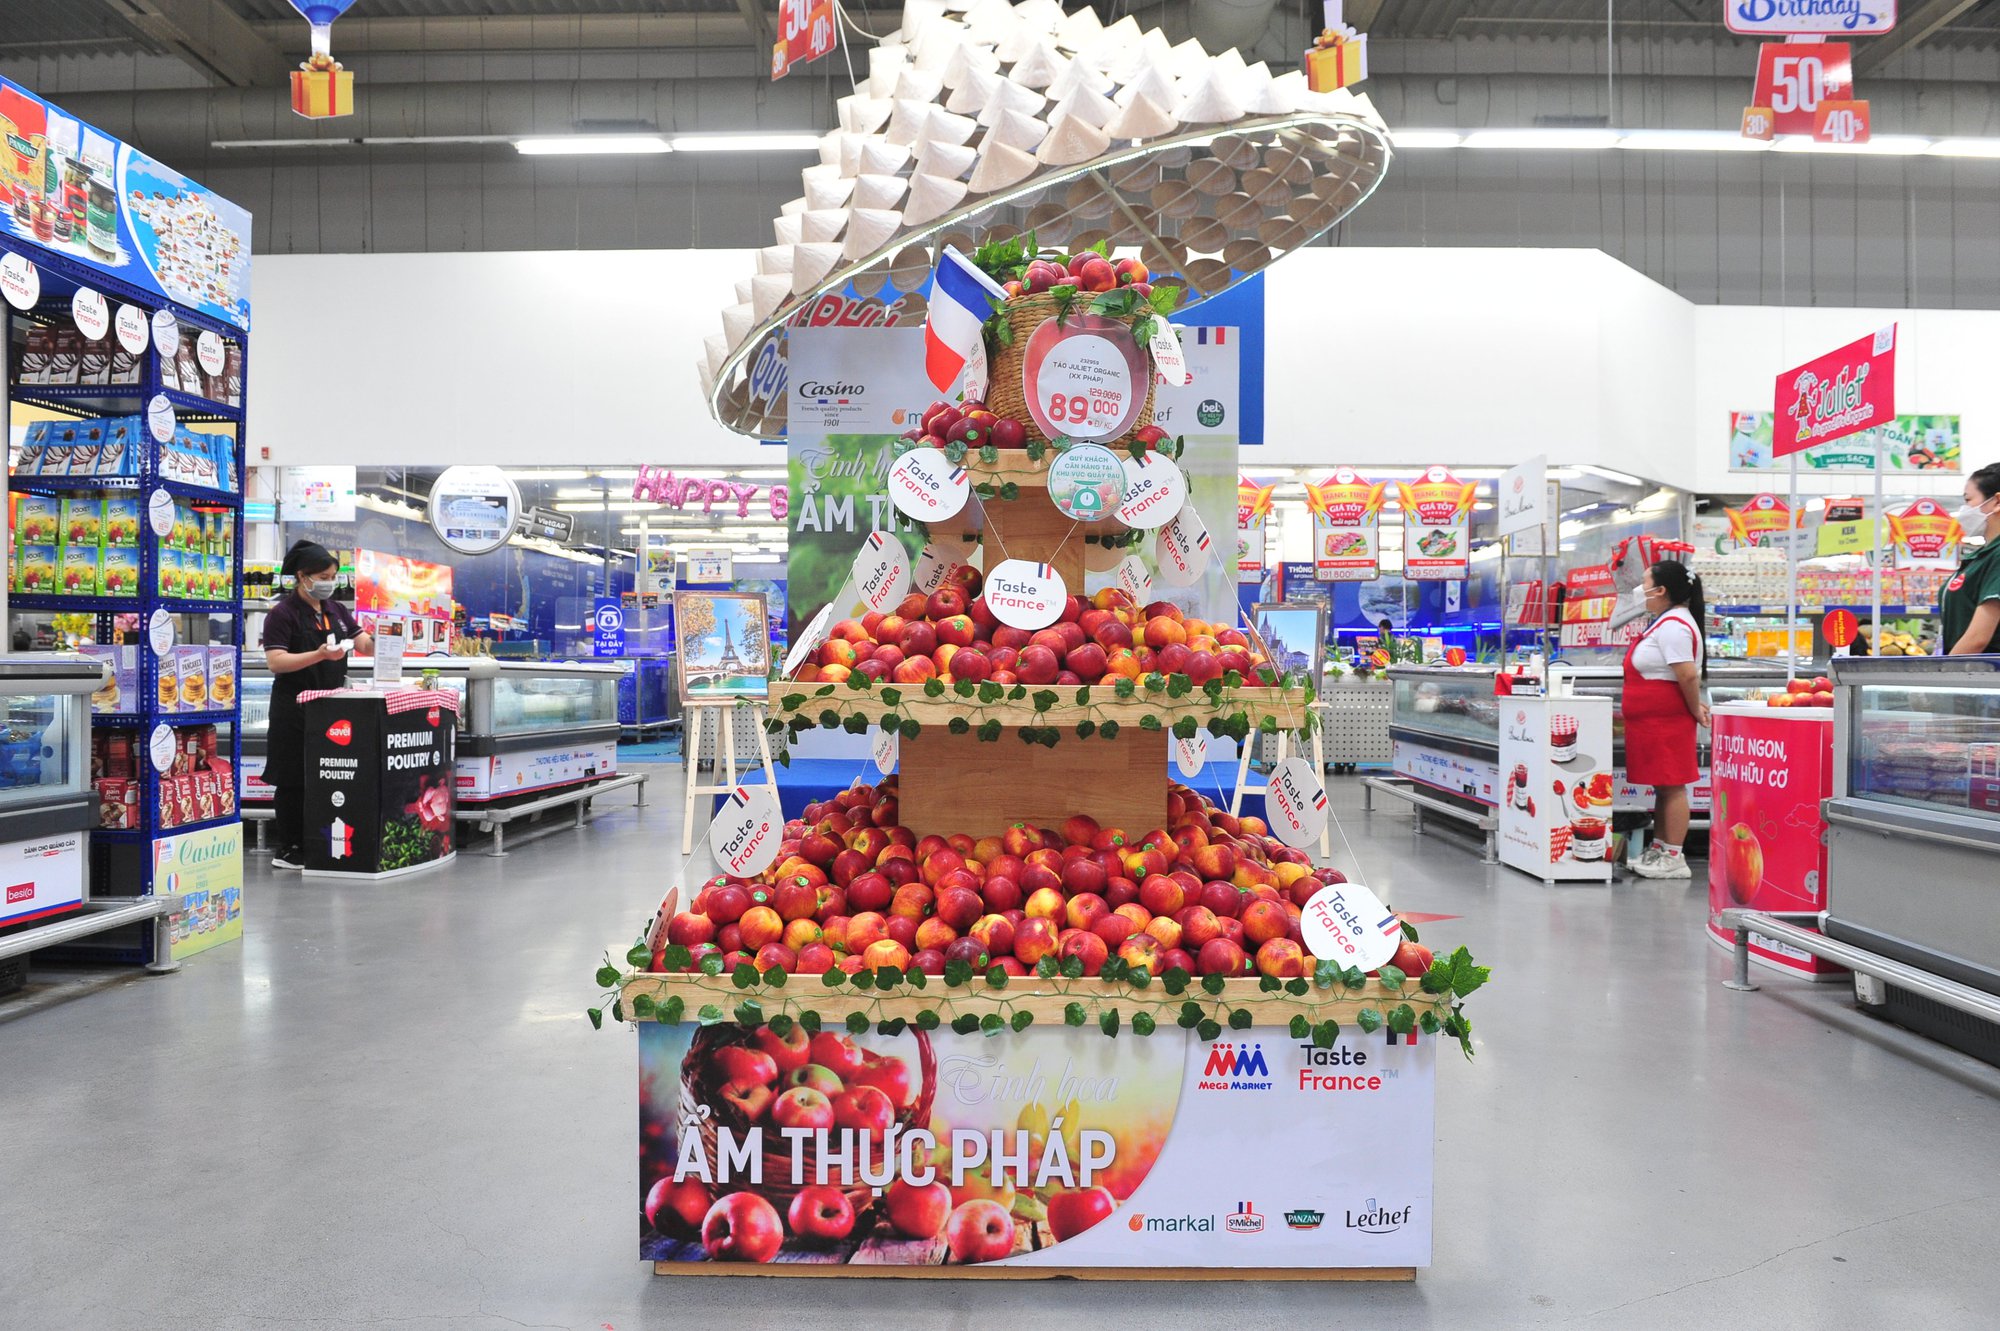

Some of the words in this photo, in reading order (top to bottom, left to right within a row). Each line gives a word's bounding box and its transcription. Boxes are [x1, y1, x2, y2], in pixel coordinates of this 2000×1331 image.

[3, 264, 25, 283] Taste
[1, 276, 29, 296] France
[77, 300, 97, 315] Taste
[76, 310, 100, 327] France
[119, 317, 138, 330] Taste
[119, 327, 142, 342] France
[1152, 337, 1172, 351] Taste
[1155, 353, 1180, 367] France
[1069, 364, 1092, 372] JULIET
[1094, 367, 1120, 378] ORGANIC
[798, 381, 865, 399] Casino
[1816, 364, 1866, 420] Juliet
[824, 418, 840, 427] 1901
[904, 457, 940, 490] Taste
[633, 463, 759, 520] HAPPY
[893, 468, 938, 508] France
[1121, 478, 1152, 505] aste
[26, 504, 45, 512] POCKET
[71, 505, 90, 513] POCKET
[109, 506, 127, 514] POCKET
[796, 481, 854, 532] ẨM
[1121, 485, 1169, 521] France
[1330, 503, 1345, 512] GIÁ
[538, 516, 566, 530] VietGAP
[1170, 517, 1190, 554] Taste
[26, 551, 44, 560] POCKET
[66, 552, 85, 561] POCKET
[107, 554, 127, 562] POCKET
[1160, 526, 1186, 572] France
[862, 561, 888, 595] Taste
[925, 562, 944, 590] Taste
[1125, 561, 1139, 589] Taste
[870, 565, 900, 609] France
[994, 579, 1037, 595] Taste
[990, 593, 1045, 611] France
[182, 660, 202, 671] PANCAKES
[212, 660, 232, 670] PANCAKES
[387, 731, 433, 749] PREMIUM
[1724, 735, 1744, 754] TƯƠI
[1748, 738, 1787, 762] NGON,
[320, 758, 358, 768] PREMIUM
[387, 751, 430, 771] POULTRY
[320, 770, 355, 780] POULTRY
[1741, 761, 1763, 784] HỮU
[1768, 768, 1789, 788] CƠ
[106, 789, 119, 797] pain
[1282, 767, 1304, 811] Taste
[1270, 777, 1299, 830] France
[720, 817, 754, 857] Taste
[730, 820, 770, 873] France
[180, 836, 236, 866] Casino
[1328, 891, 1363, 936] Taste
[1309, 900, 1355, 955] France
[1300, 1045, 1367, 1066] Taste
[939, 1053, 1044, 1112] Tinh
[1060, 1056, 1120, 1112] hoa
[1299, 1069, 1381, 1091] France
[672, 1103, 762, 1184] ẨM
[781, 1121, 936, 1198] THỰC
[952, 1116, 1117, 1188] PHÁP
[1147, 1214, 1214, 1232] markal
[1288, 1214, 1320, 1223] PANZANI
[1346, 1205, 1411, 1229] Lechef
